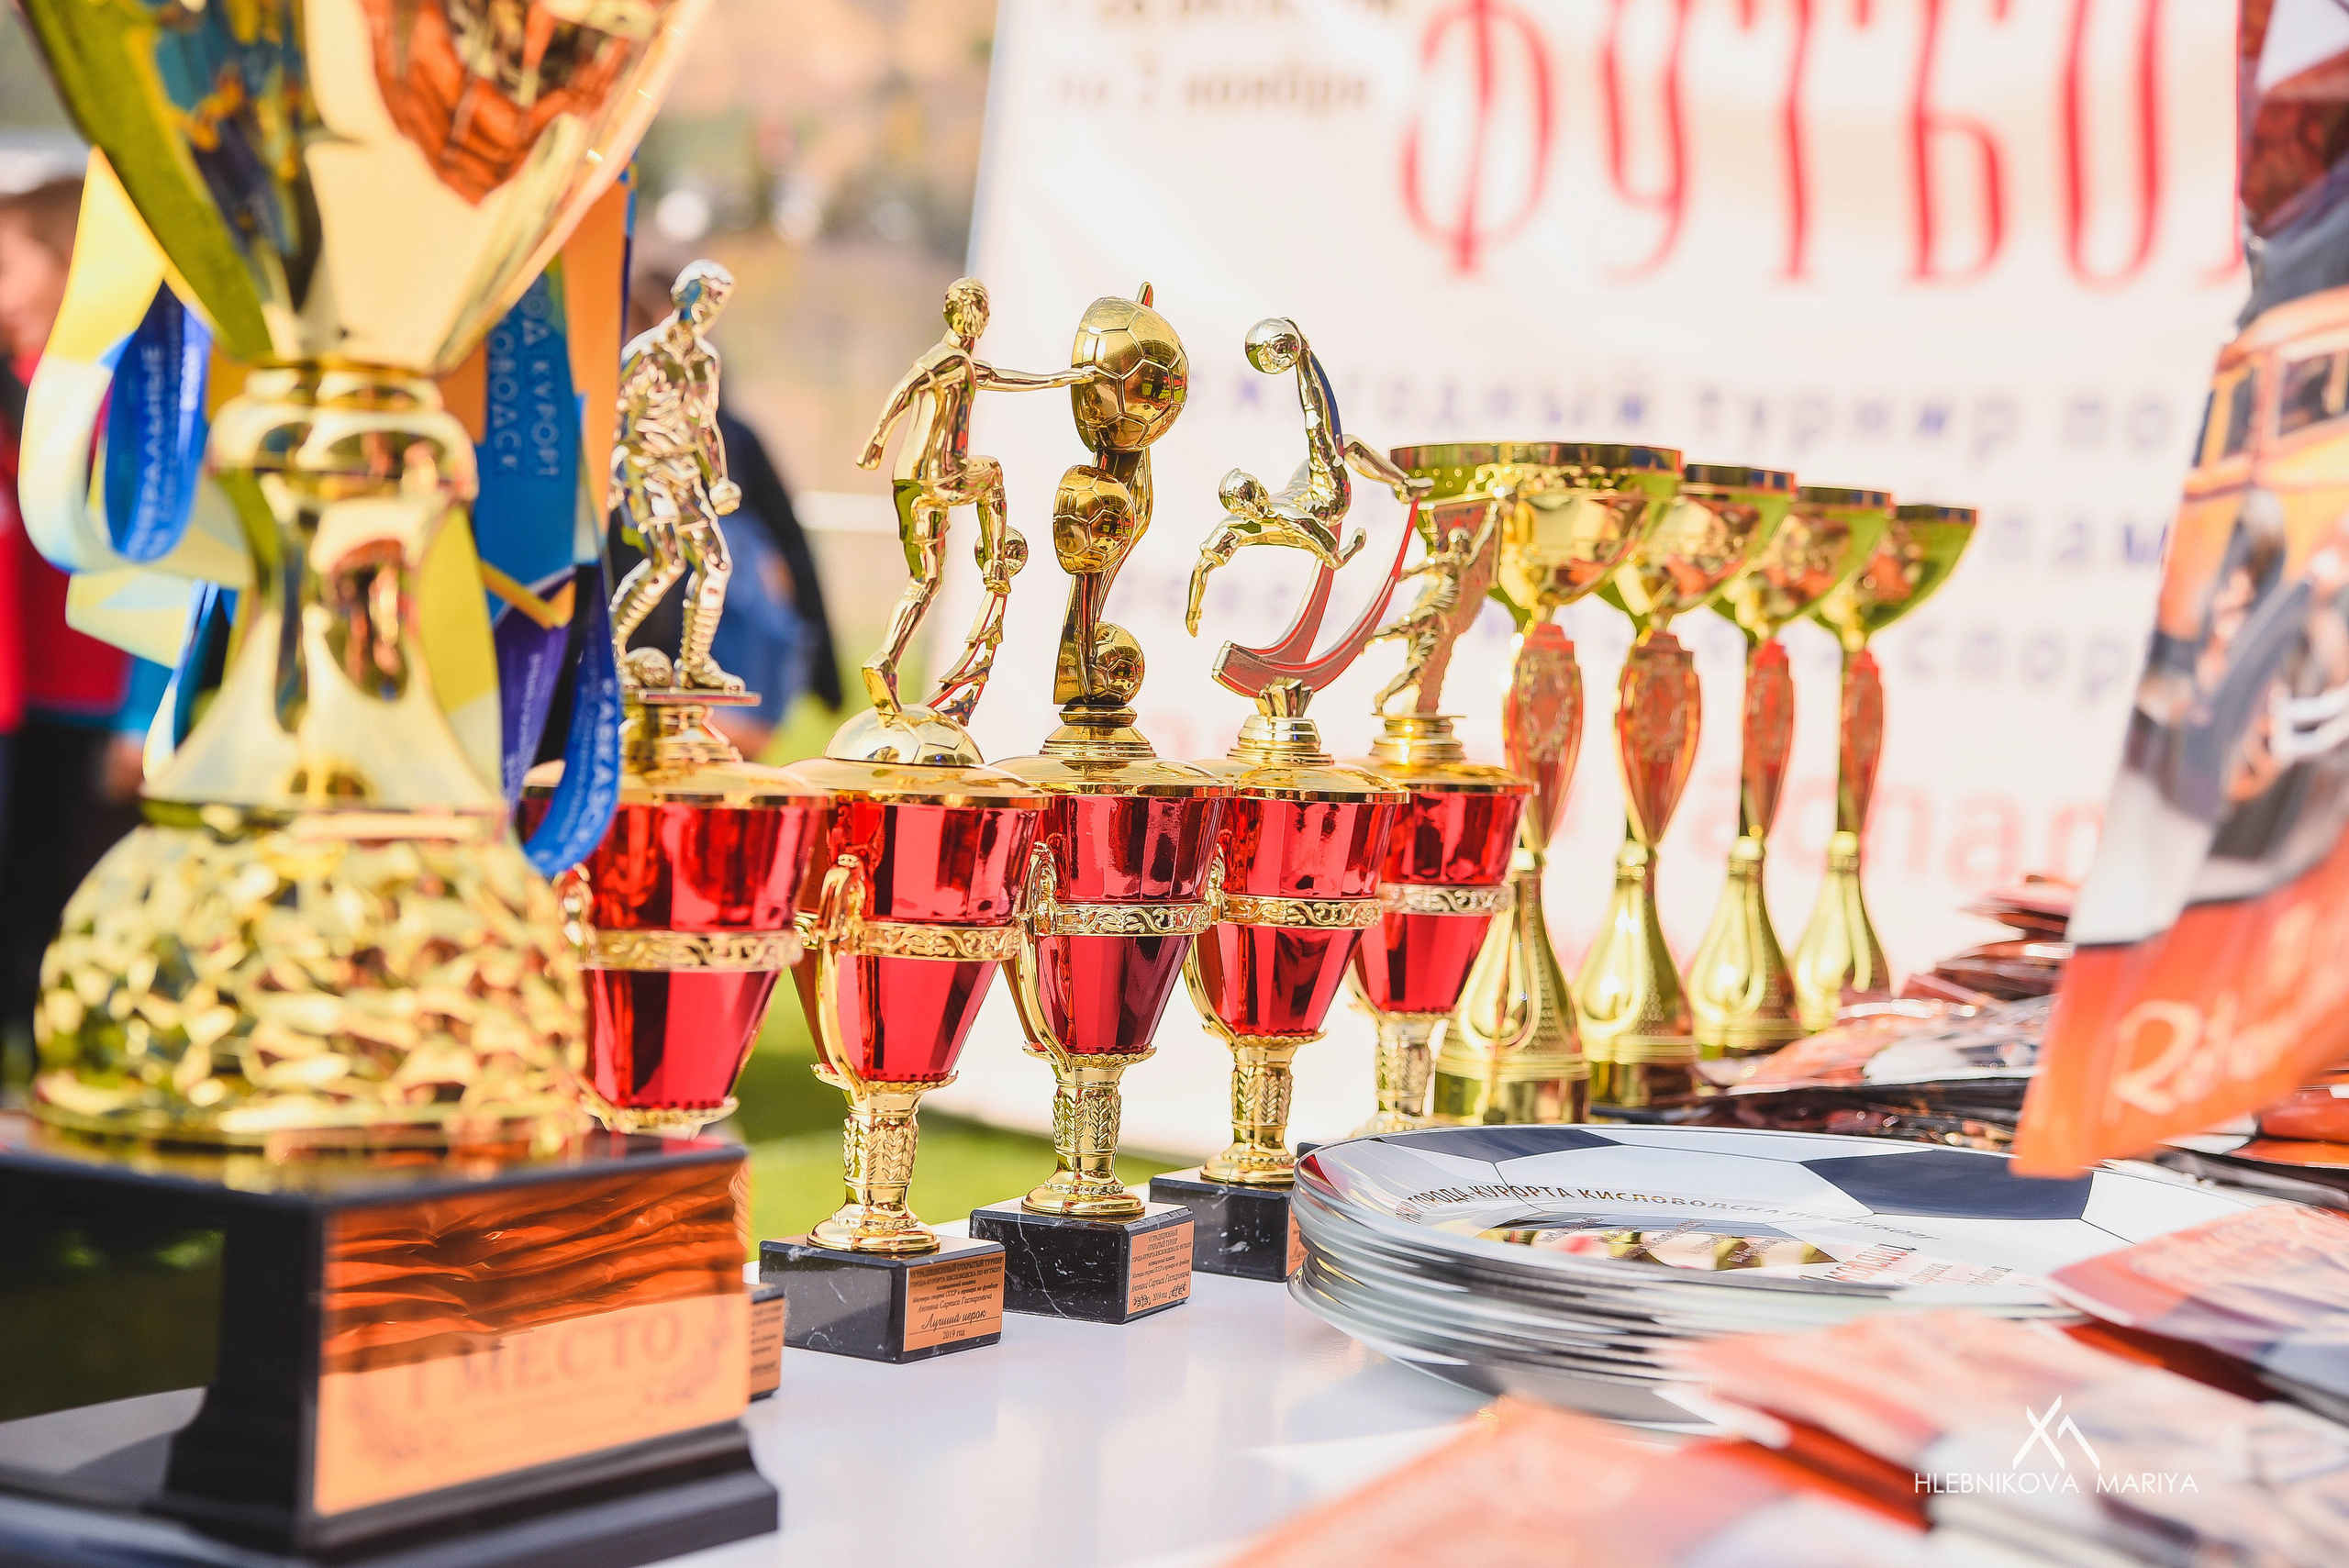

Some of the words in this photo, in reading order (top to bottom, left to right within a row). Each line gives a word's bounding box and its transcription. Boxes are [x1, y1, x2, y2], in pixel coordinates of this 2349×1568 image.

[1408, 1185, 1575, 1210] ГОРОДА-КУРОРТА
[1576, 1188, 1779, 1213] КИСЛОВОДСКА
[940, 1300, 960, 1309] Саркиса
[961, 1294, 992, 1305] Гаспаровича
[921, 1314, 960, 1332] Лучший
[963, 1309, 987, 1325] игрок
[942, 1329, 955, 1340] 2019
[456, 1309, 683, 1402] МЕСТО
